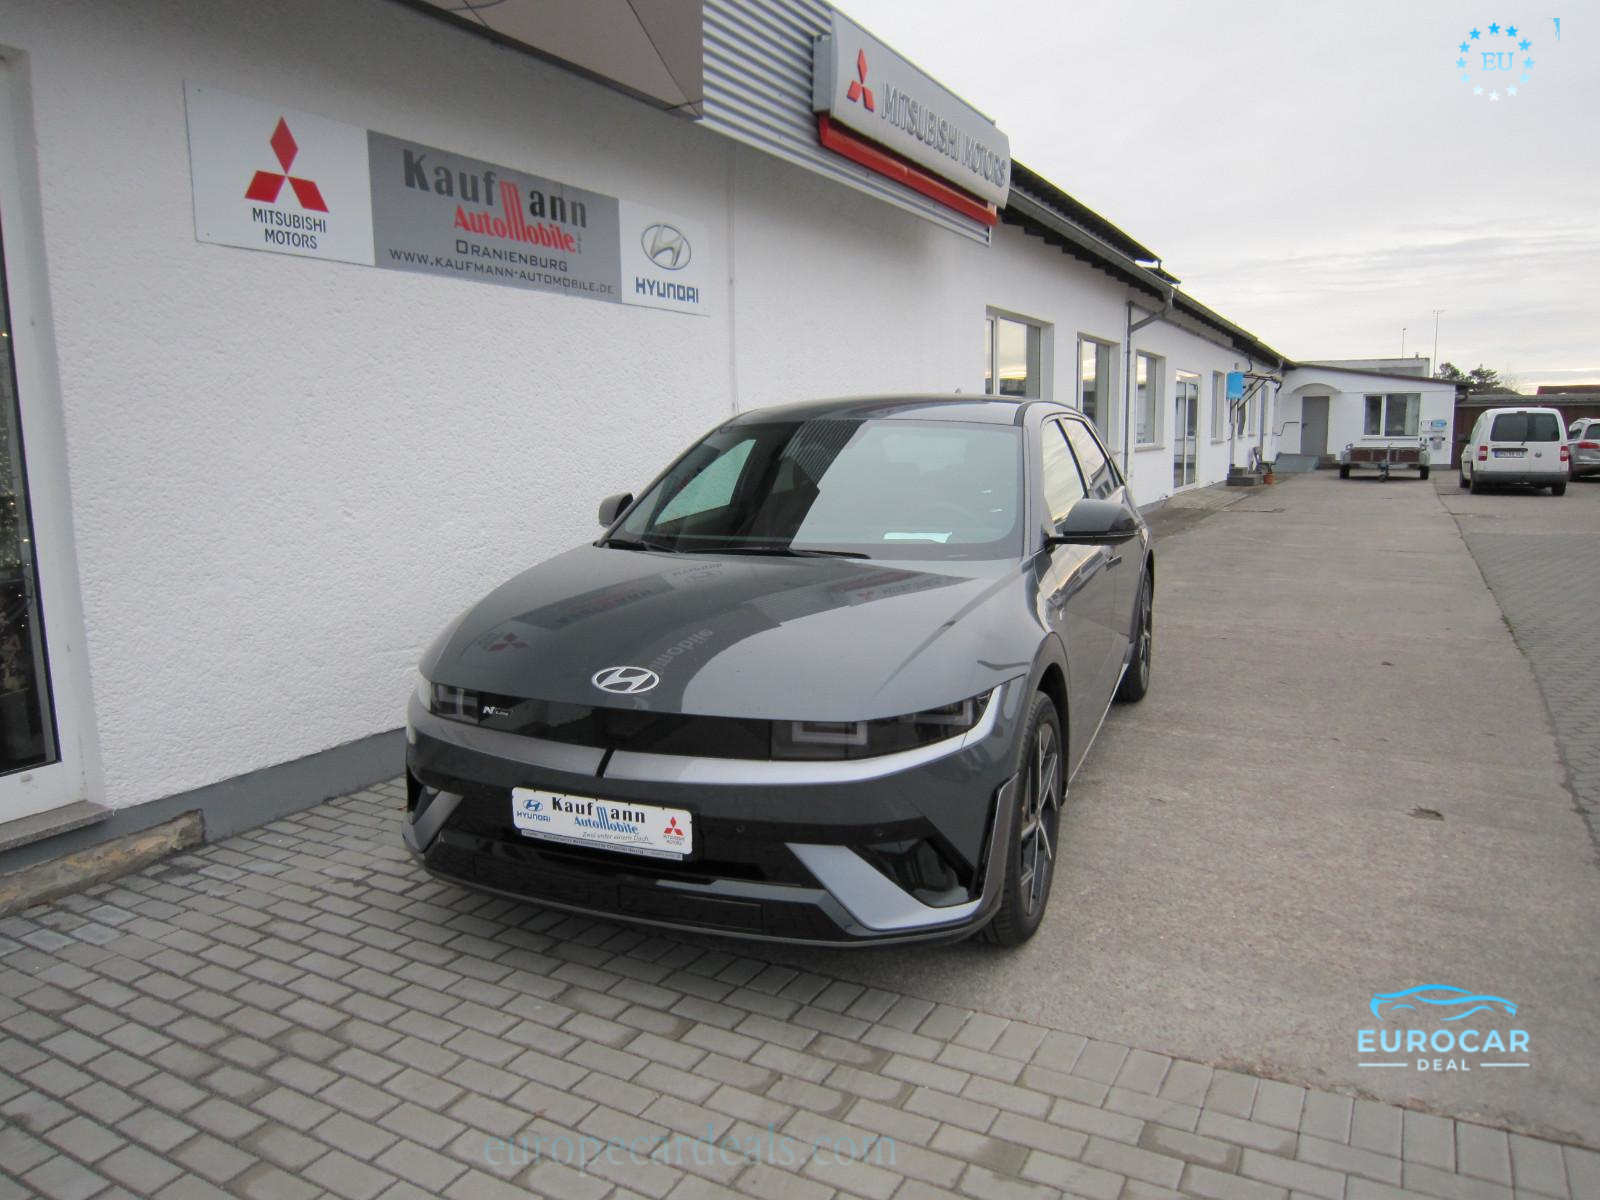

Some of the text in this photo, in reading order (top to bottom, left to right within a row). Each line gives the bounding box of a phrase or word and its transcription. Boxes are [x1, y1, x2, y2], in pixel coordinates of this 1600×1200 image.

[881, 81, 1007, 188] MITSUBISHI MOTORS
[252, 207, 327, 233] MITSUBISHI
[264, 228, 318, 250] MOTORS
[635, 276, 699, 304] HYUNDAI
[516, 810, 551, 823] HYUNDAI
